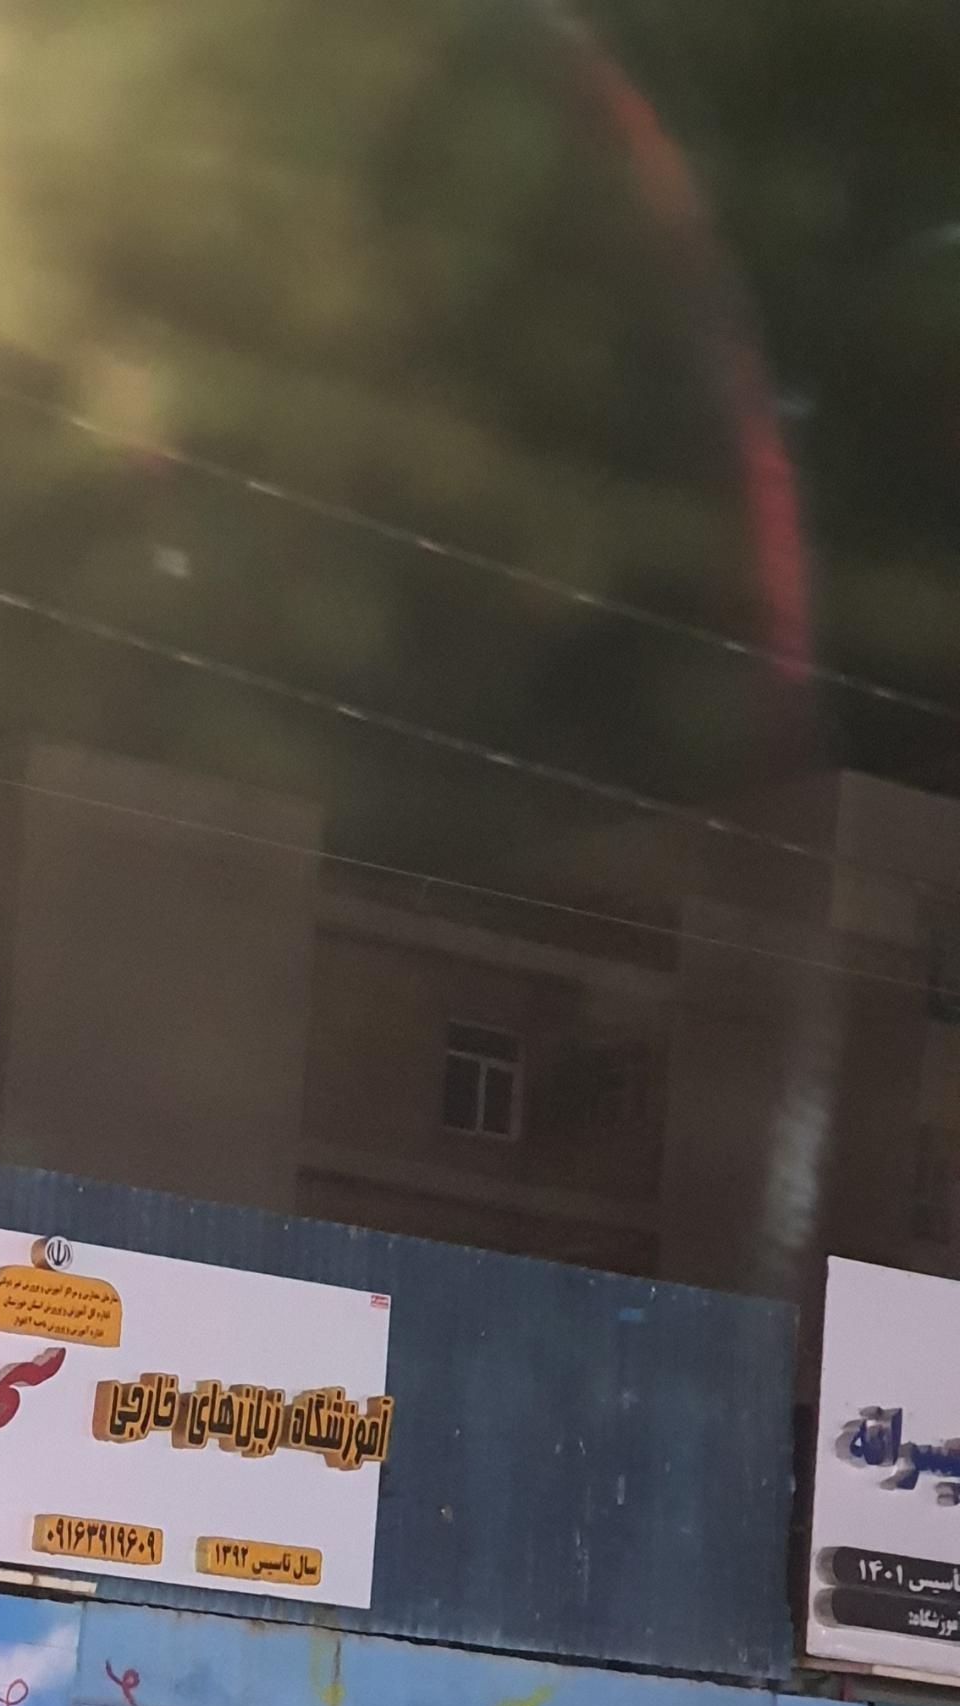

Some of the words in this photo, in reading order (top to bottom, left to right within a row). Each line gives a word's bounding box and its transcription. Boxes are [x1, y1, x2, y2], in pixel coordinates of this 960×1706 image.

[109, 1374, 178, 1438] خارجی
[290, 1386, 392, 1468] آموزشگاه
[46, 1517, 156, 1562] ۰۹۱۶۳۹۱۹۶۰۹
[251, 1552, 292, 1575] تاسیس
[292, 1554, 318, 1581] سال
[858, 1558, 904, 1586] ۱۴۰۱
[908, 1607, 960, 1637] موزشگاه:
